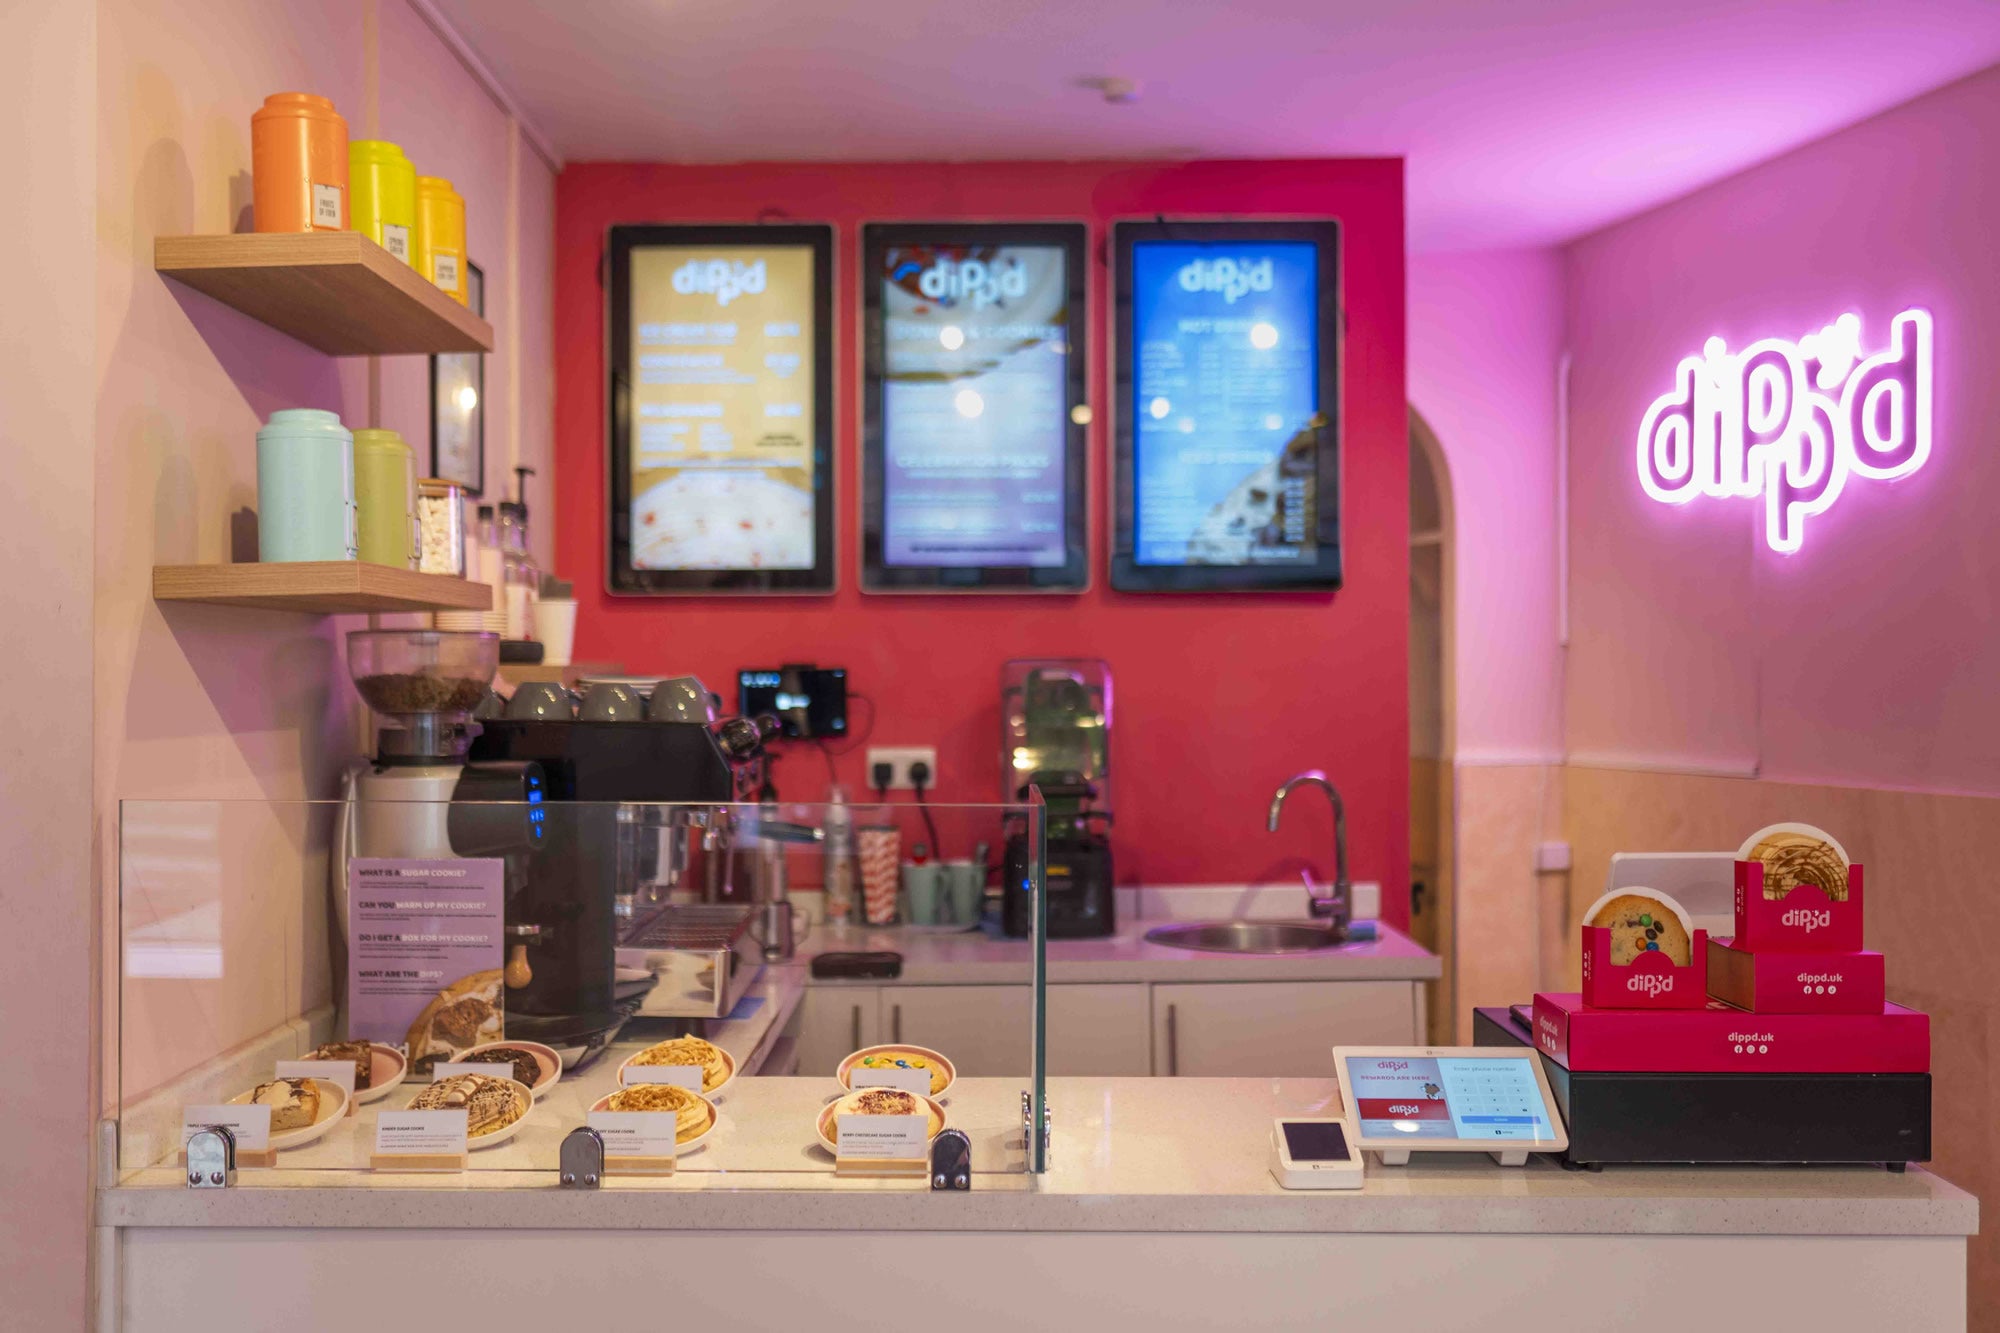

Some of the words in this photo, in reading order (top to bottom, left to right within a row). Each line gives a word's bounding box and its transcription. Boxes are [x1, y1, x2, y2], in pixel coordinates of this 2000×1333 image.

[359, 869, 384, 877] WHAT
[385, 869, 393, 877] IS
[394, 869, 400, 877] A
[401, 869, 430, 877] SUGAR
[431, 869, 467, 877] COOKIE?
[396, 902, 422, 910] WARM
[424, 902, 435, 910] UP
[436, 902, 449, 910] MY
[450, 902, 486, 910] COOKIE?
[359, 934, 371, 942] DO
[377, 934, 393, 942] GET
[402, 934, 420, 942] BOX
[420, 934, 438, 942] FOR
[452, 934, 488, 942] COOKIE?
[359, 970, 384, 978] WHAT
[385, 970, 401, 978] ARE
[402, 970, 419, 978] THE
[1797, 972, 1843, 984] dippd.uk
[1728, 1032, 1774, 1043] dippd.uk
